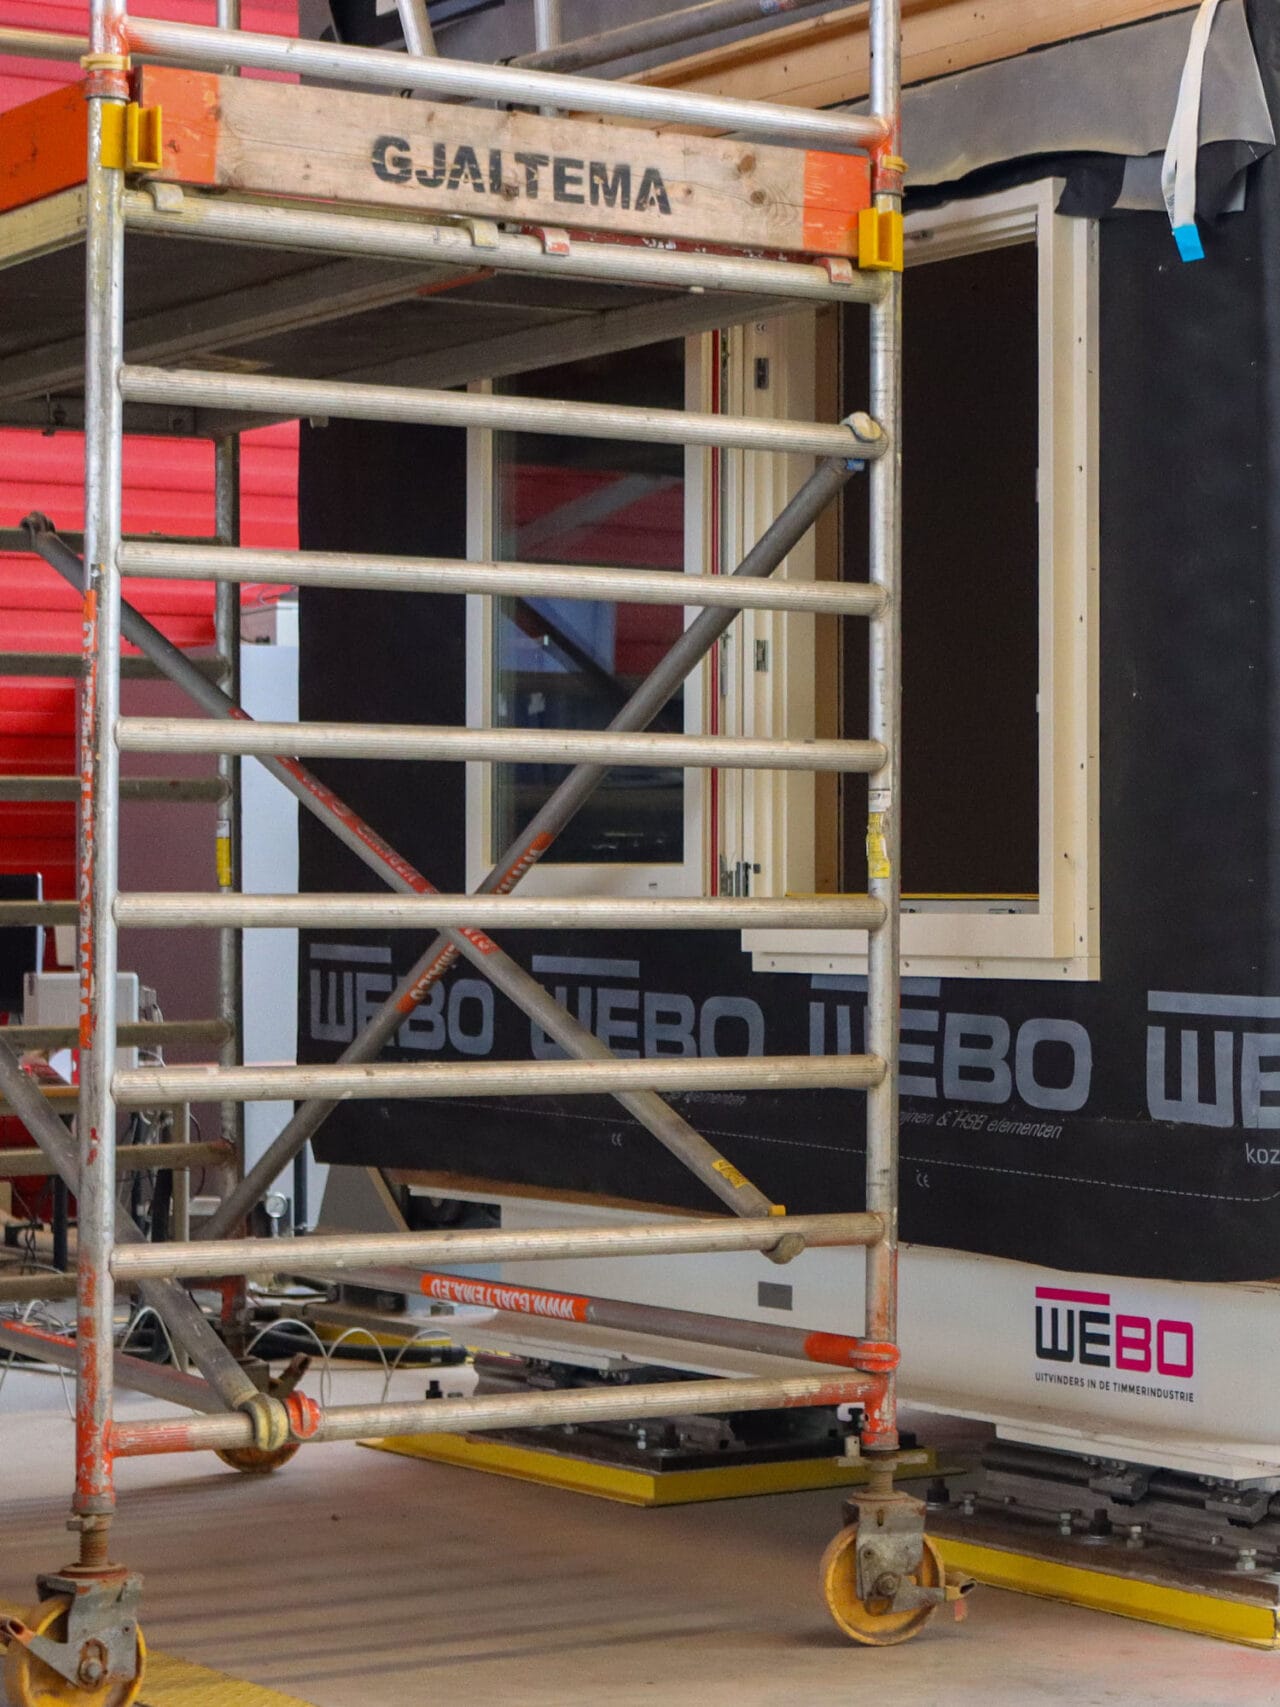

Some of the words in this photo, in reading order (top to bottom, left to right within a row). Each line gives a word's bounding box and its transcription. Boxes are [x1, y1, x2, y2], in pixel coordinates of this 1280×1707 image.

[371, 135, 672, 215] GJALTEMA
[952, 1110, 986, 1131] HSB
[987, 1117, 1063, 1140] elementen
[430, 1278, 576, 1320] WWW.GJALTEMA.EU
[1035, 1306, 1194, 1379] WEBO
[1035, 1372, 1085, 1388] UITVINDERS
[1087, 1378, 1097, 1390] IN
[1099, 1380, 1110, 1391] DE
[1113, 1382, 1195, 1403] TIMMERINDUSTRIE
